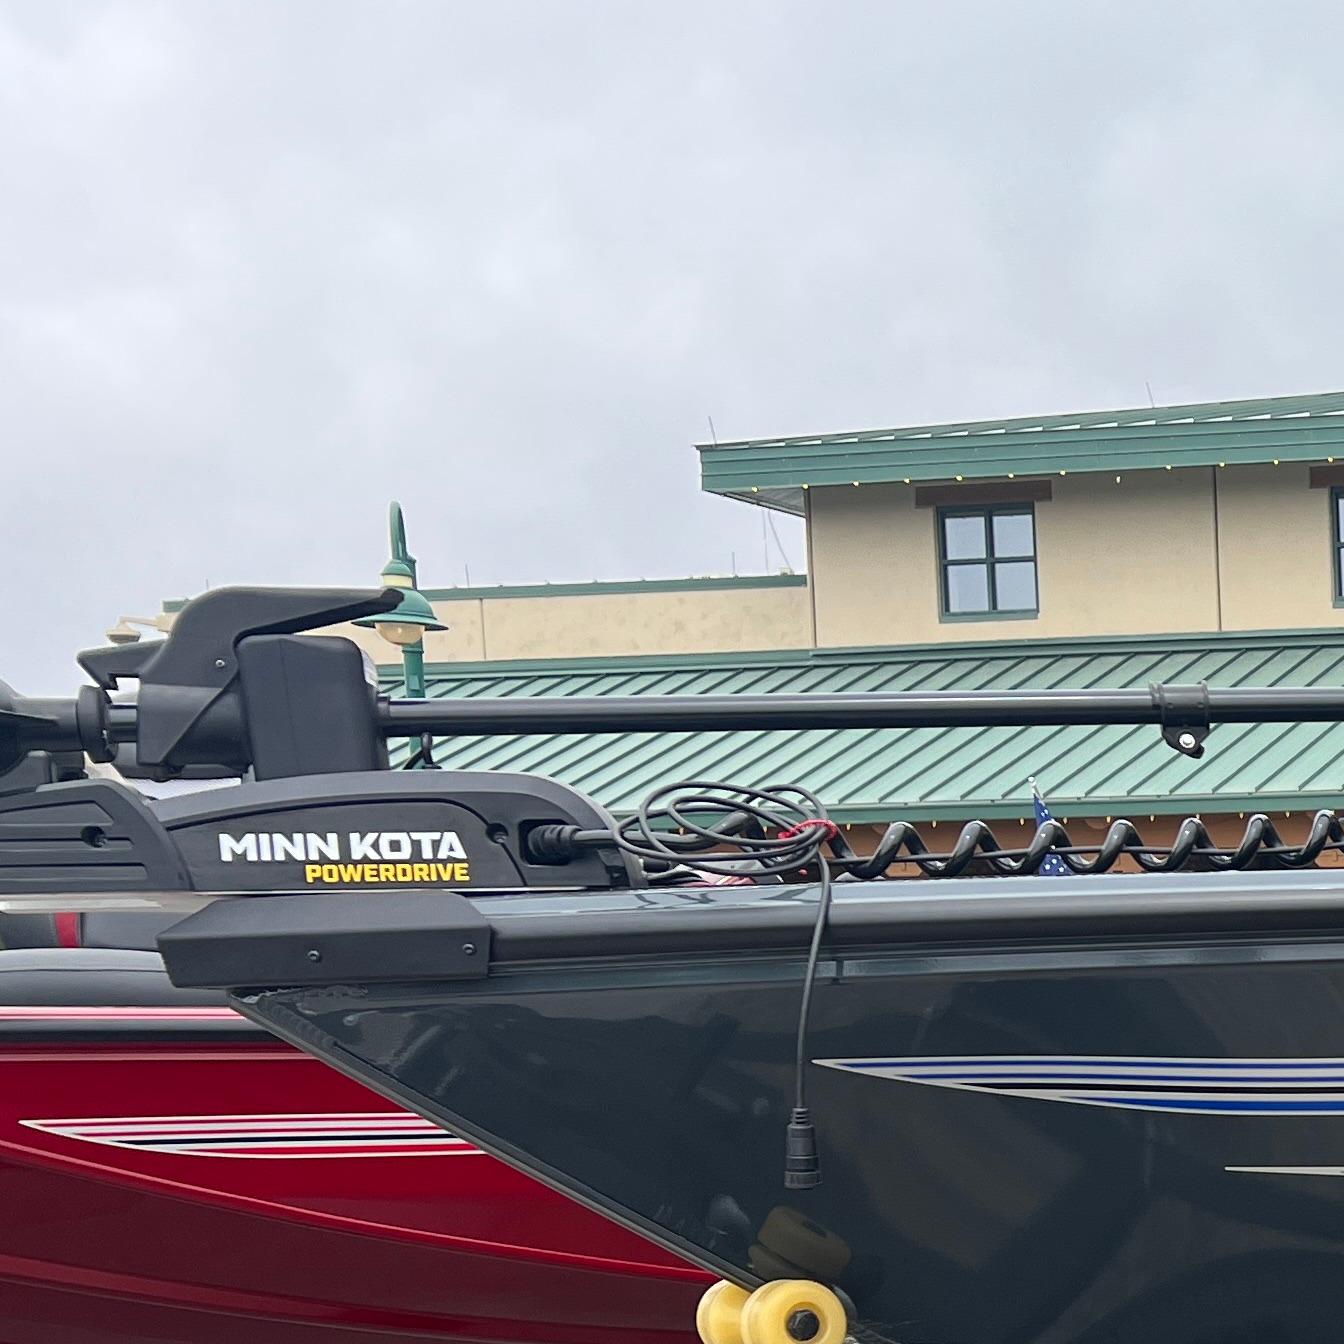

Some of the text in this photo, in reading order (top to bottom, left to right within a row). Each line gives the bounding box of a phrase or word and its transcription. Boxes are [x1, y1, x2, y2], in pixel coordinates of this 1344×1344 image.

[218, 831, 468, 862] MINN KOTA
[304, 862, 471, 883] POWERDRIVE
